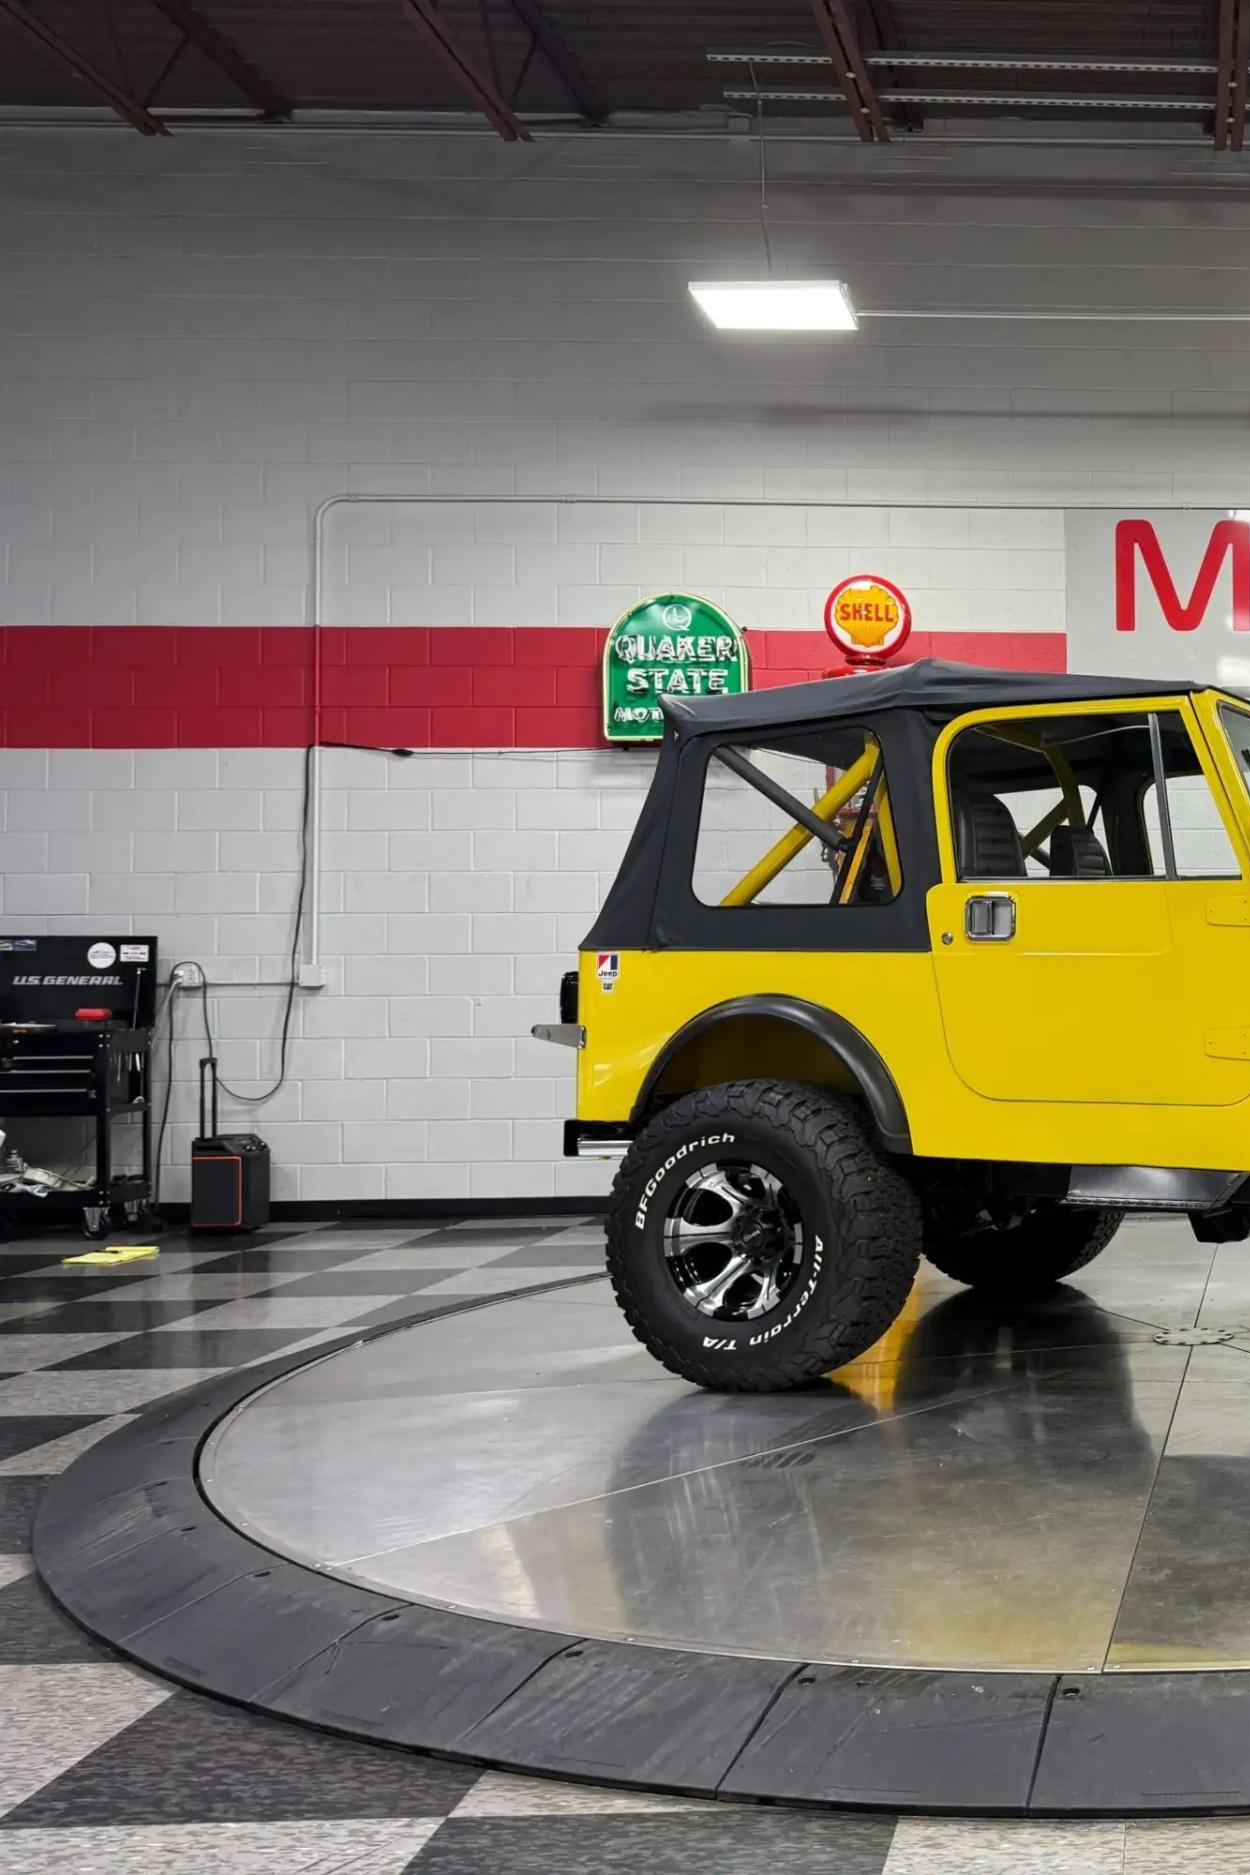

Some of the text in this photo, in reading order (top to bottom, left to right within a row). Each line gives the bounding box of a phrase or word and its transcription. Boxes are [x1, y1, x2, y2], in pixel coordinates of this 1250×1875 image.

[840, 602, 894, 623] SHELL
[615, 634, 738, 663] QUAKER
[626, 667, 729, 694] STATE
[614, 706, 665, 722] MOT
[43, 976, 123, 985] GENERAL
[598, 970, 618, 978] Jeep
[635, 1132, 735, 1230] BFGoodrich
[702, 1234, 824, 1350] All-Terrain T/A
